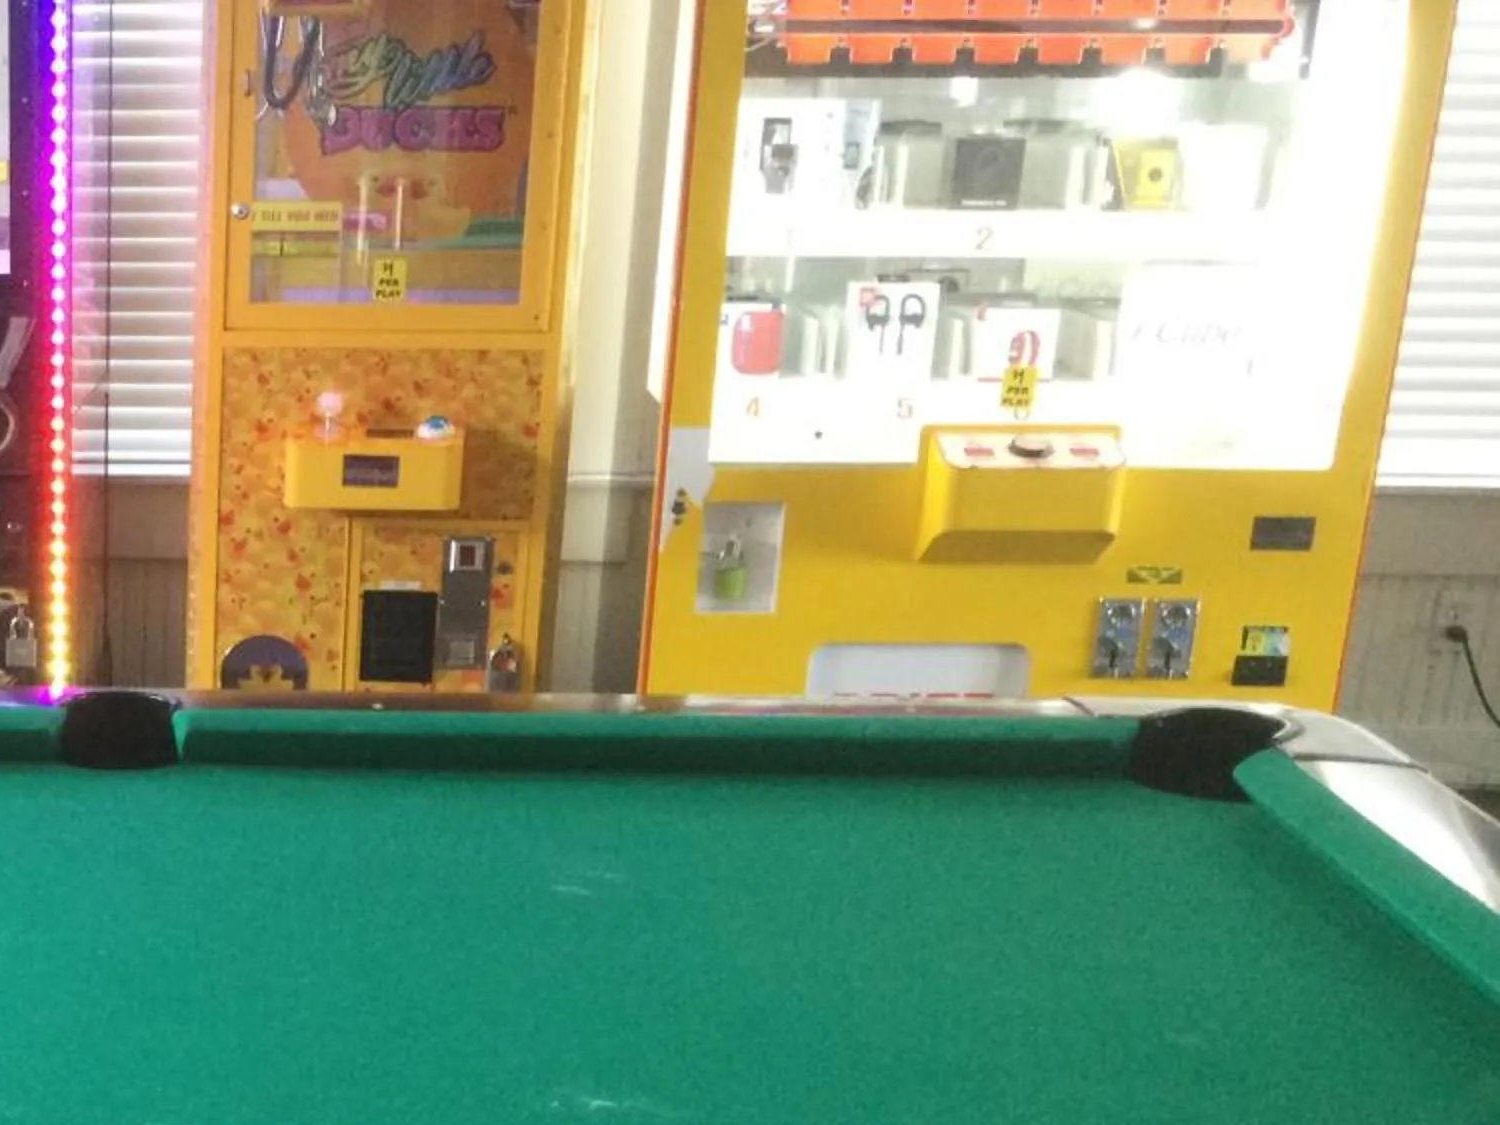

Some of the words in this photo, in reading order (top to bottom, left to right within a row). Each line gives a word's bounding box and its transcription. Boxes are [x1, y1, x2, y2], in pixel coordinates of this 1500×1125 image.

[975, 226, 994, 250] 2
[378, 277, 399, 287] PER
[375, 289, 402, 299] PLAY
[1006, 386, 1029, 396] PER
[746, 396, 760, 417] 4
[1001, 397, 1030, 407] PLAY
[896, 398, 913, 419] 5
